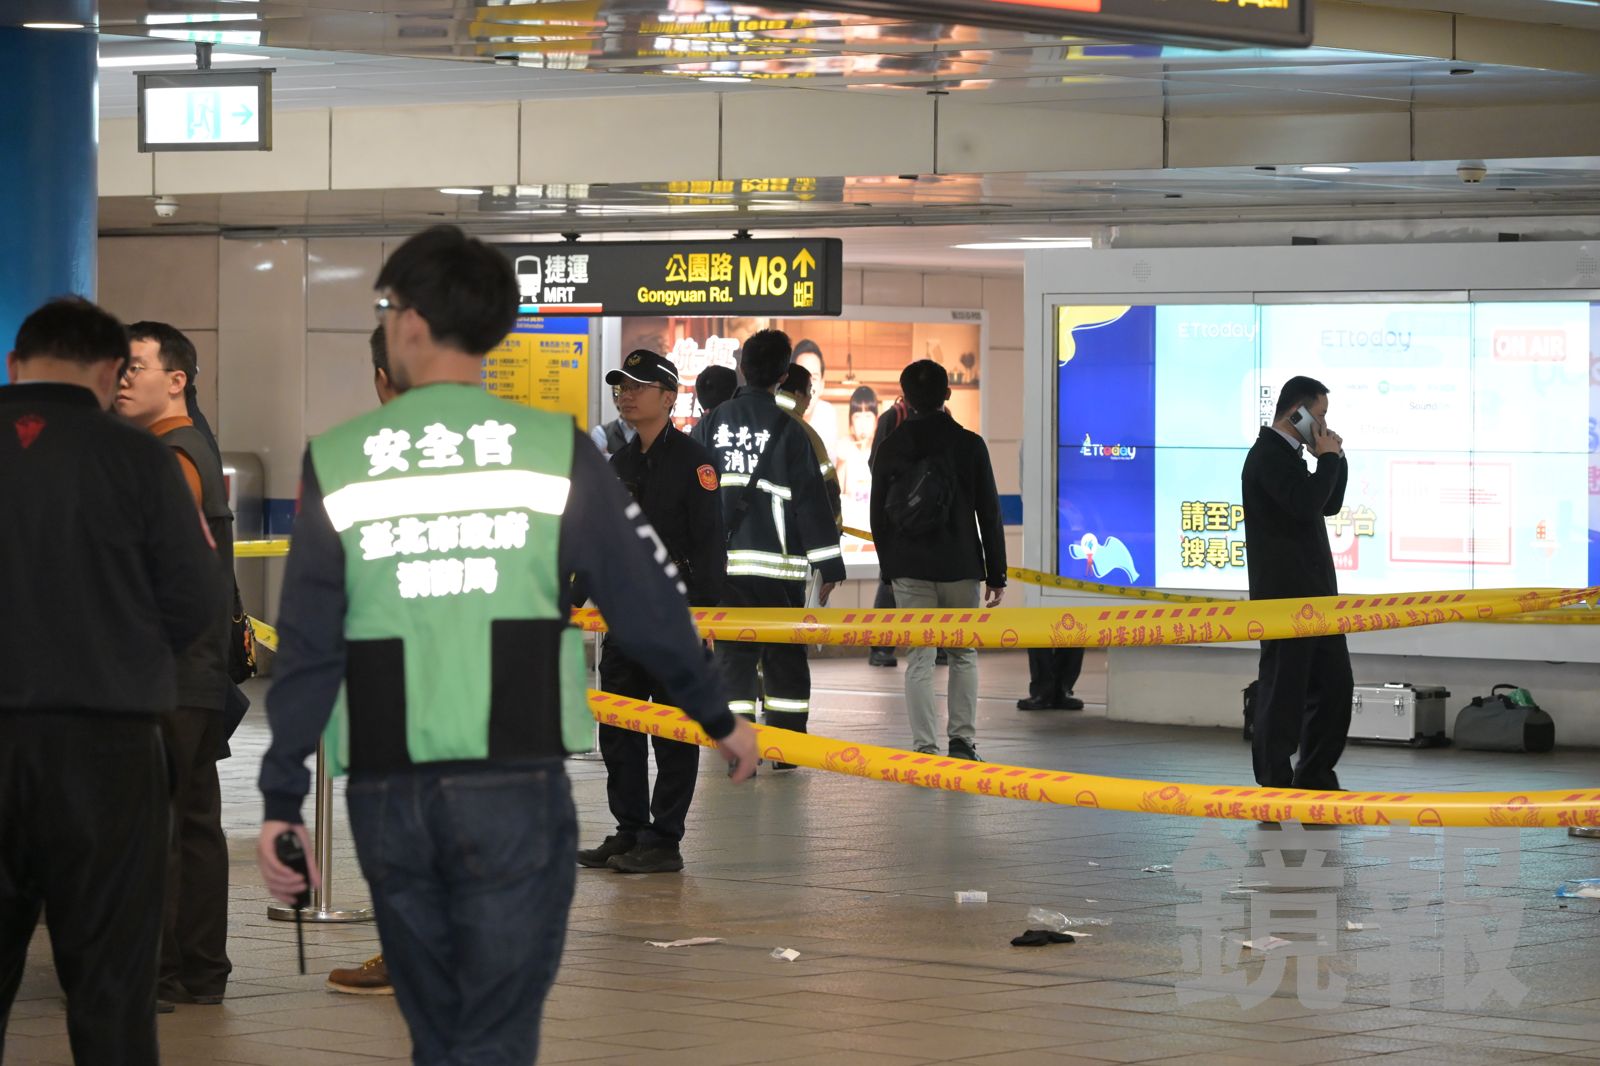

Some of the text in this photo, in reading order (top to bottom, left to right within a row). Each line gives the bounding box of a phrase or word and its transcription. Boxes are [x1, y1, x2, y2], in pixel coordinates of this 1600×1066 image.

[544, 255, 589, 284] 捷運
[665, 254, 733, 283] 公園路
[739, 256, 788, 296] M8
[543, 287, 576, 303] MRT
[637, 287, 733, 305] Gongyuan Rd.
[1320, 329, 1412, 351] ETtoday
[364, 420, 517, 477] 安全官
[713, 423, 771, 454] 臺北市
[1083, 443, 1137, 460] ETtoday
[1180, 536, 1248, 569] 搜尋E
[1098, 621, 1233, 647] 刑案現場 禁止進入
